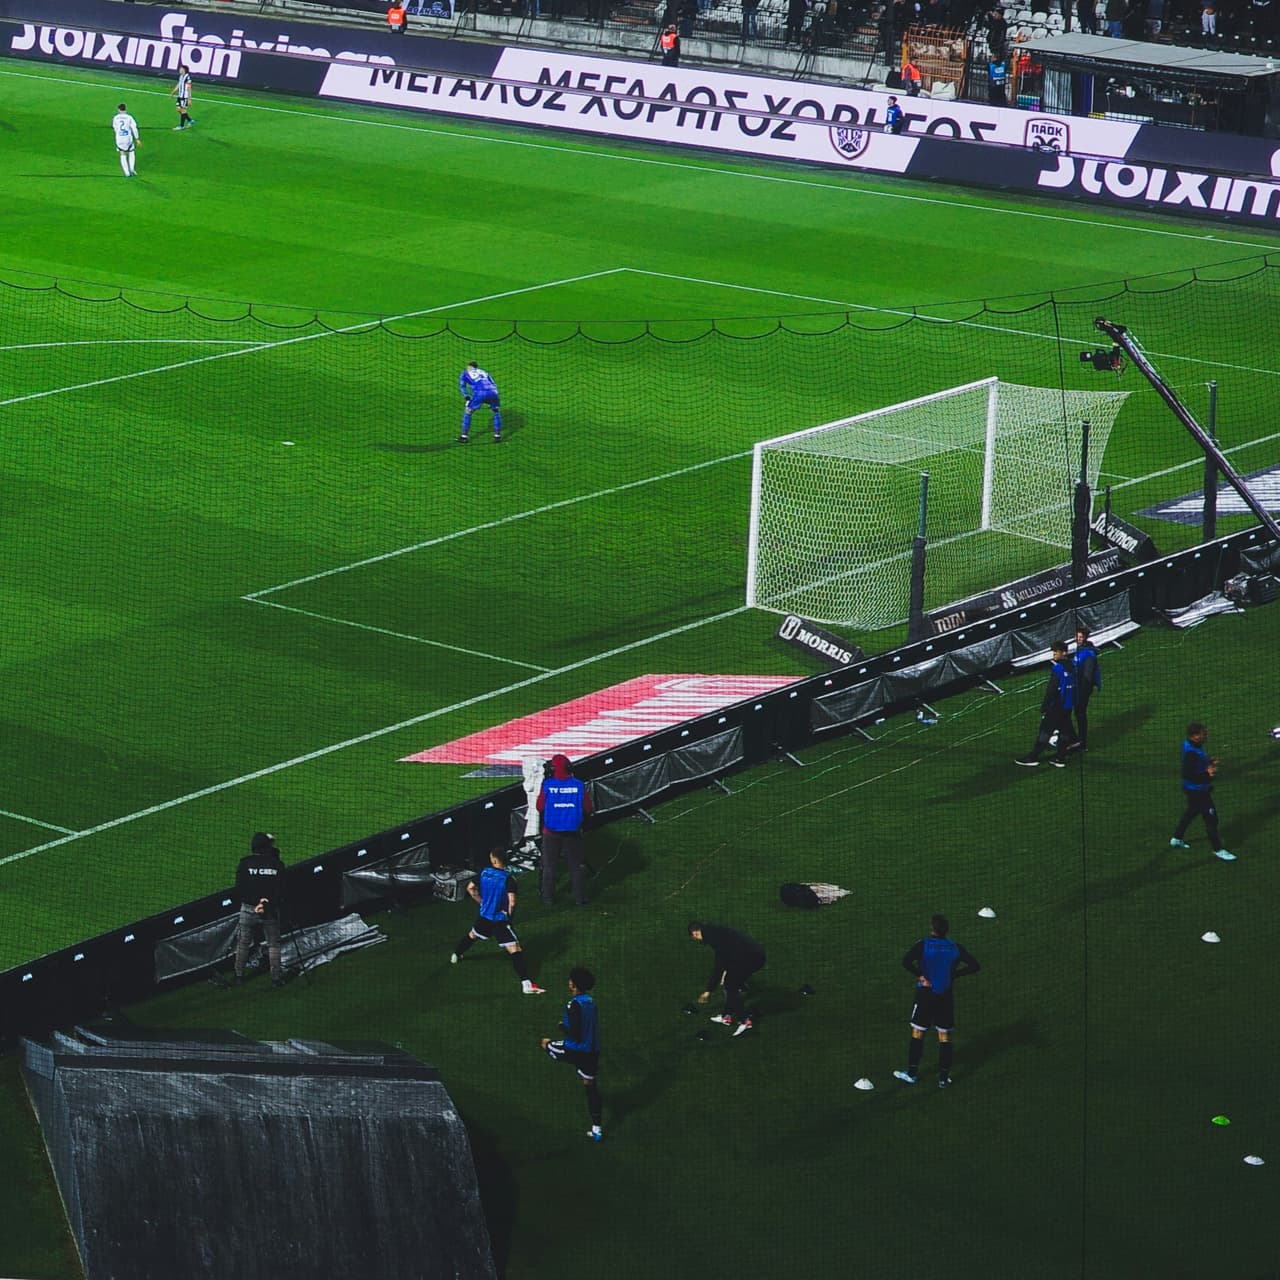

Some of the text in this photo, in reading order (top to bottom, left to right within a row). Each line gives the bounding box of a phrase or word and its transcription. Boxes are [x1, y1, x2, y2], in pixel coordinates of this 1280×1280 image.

[119, 120, 126, 131] 2
[1031, 123, 1063, 137] ΠΑΟΚ
[1016, 577, 1063, 603] MILLIONERO
[796, 628, 853, 665] MORRIS
[248, 867, 258, 876] TV
